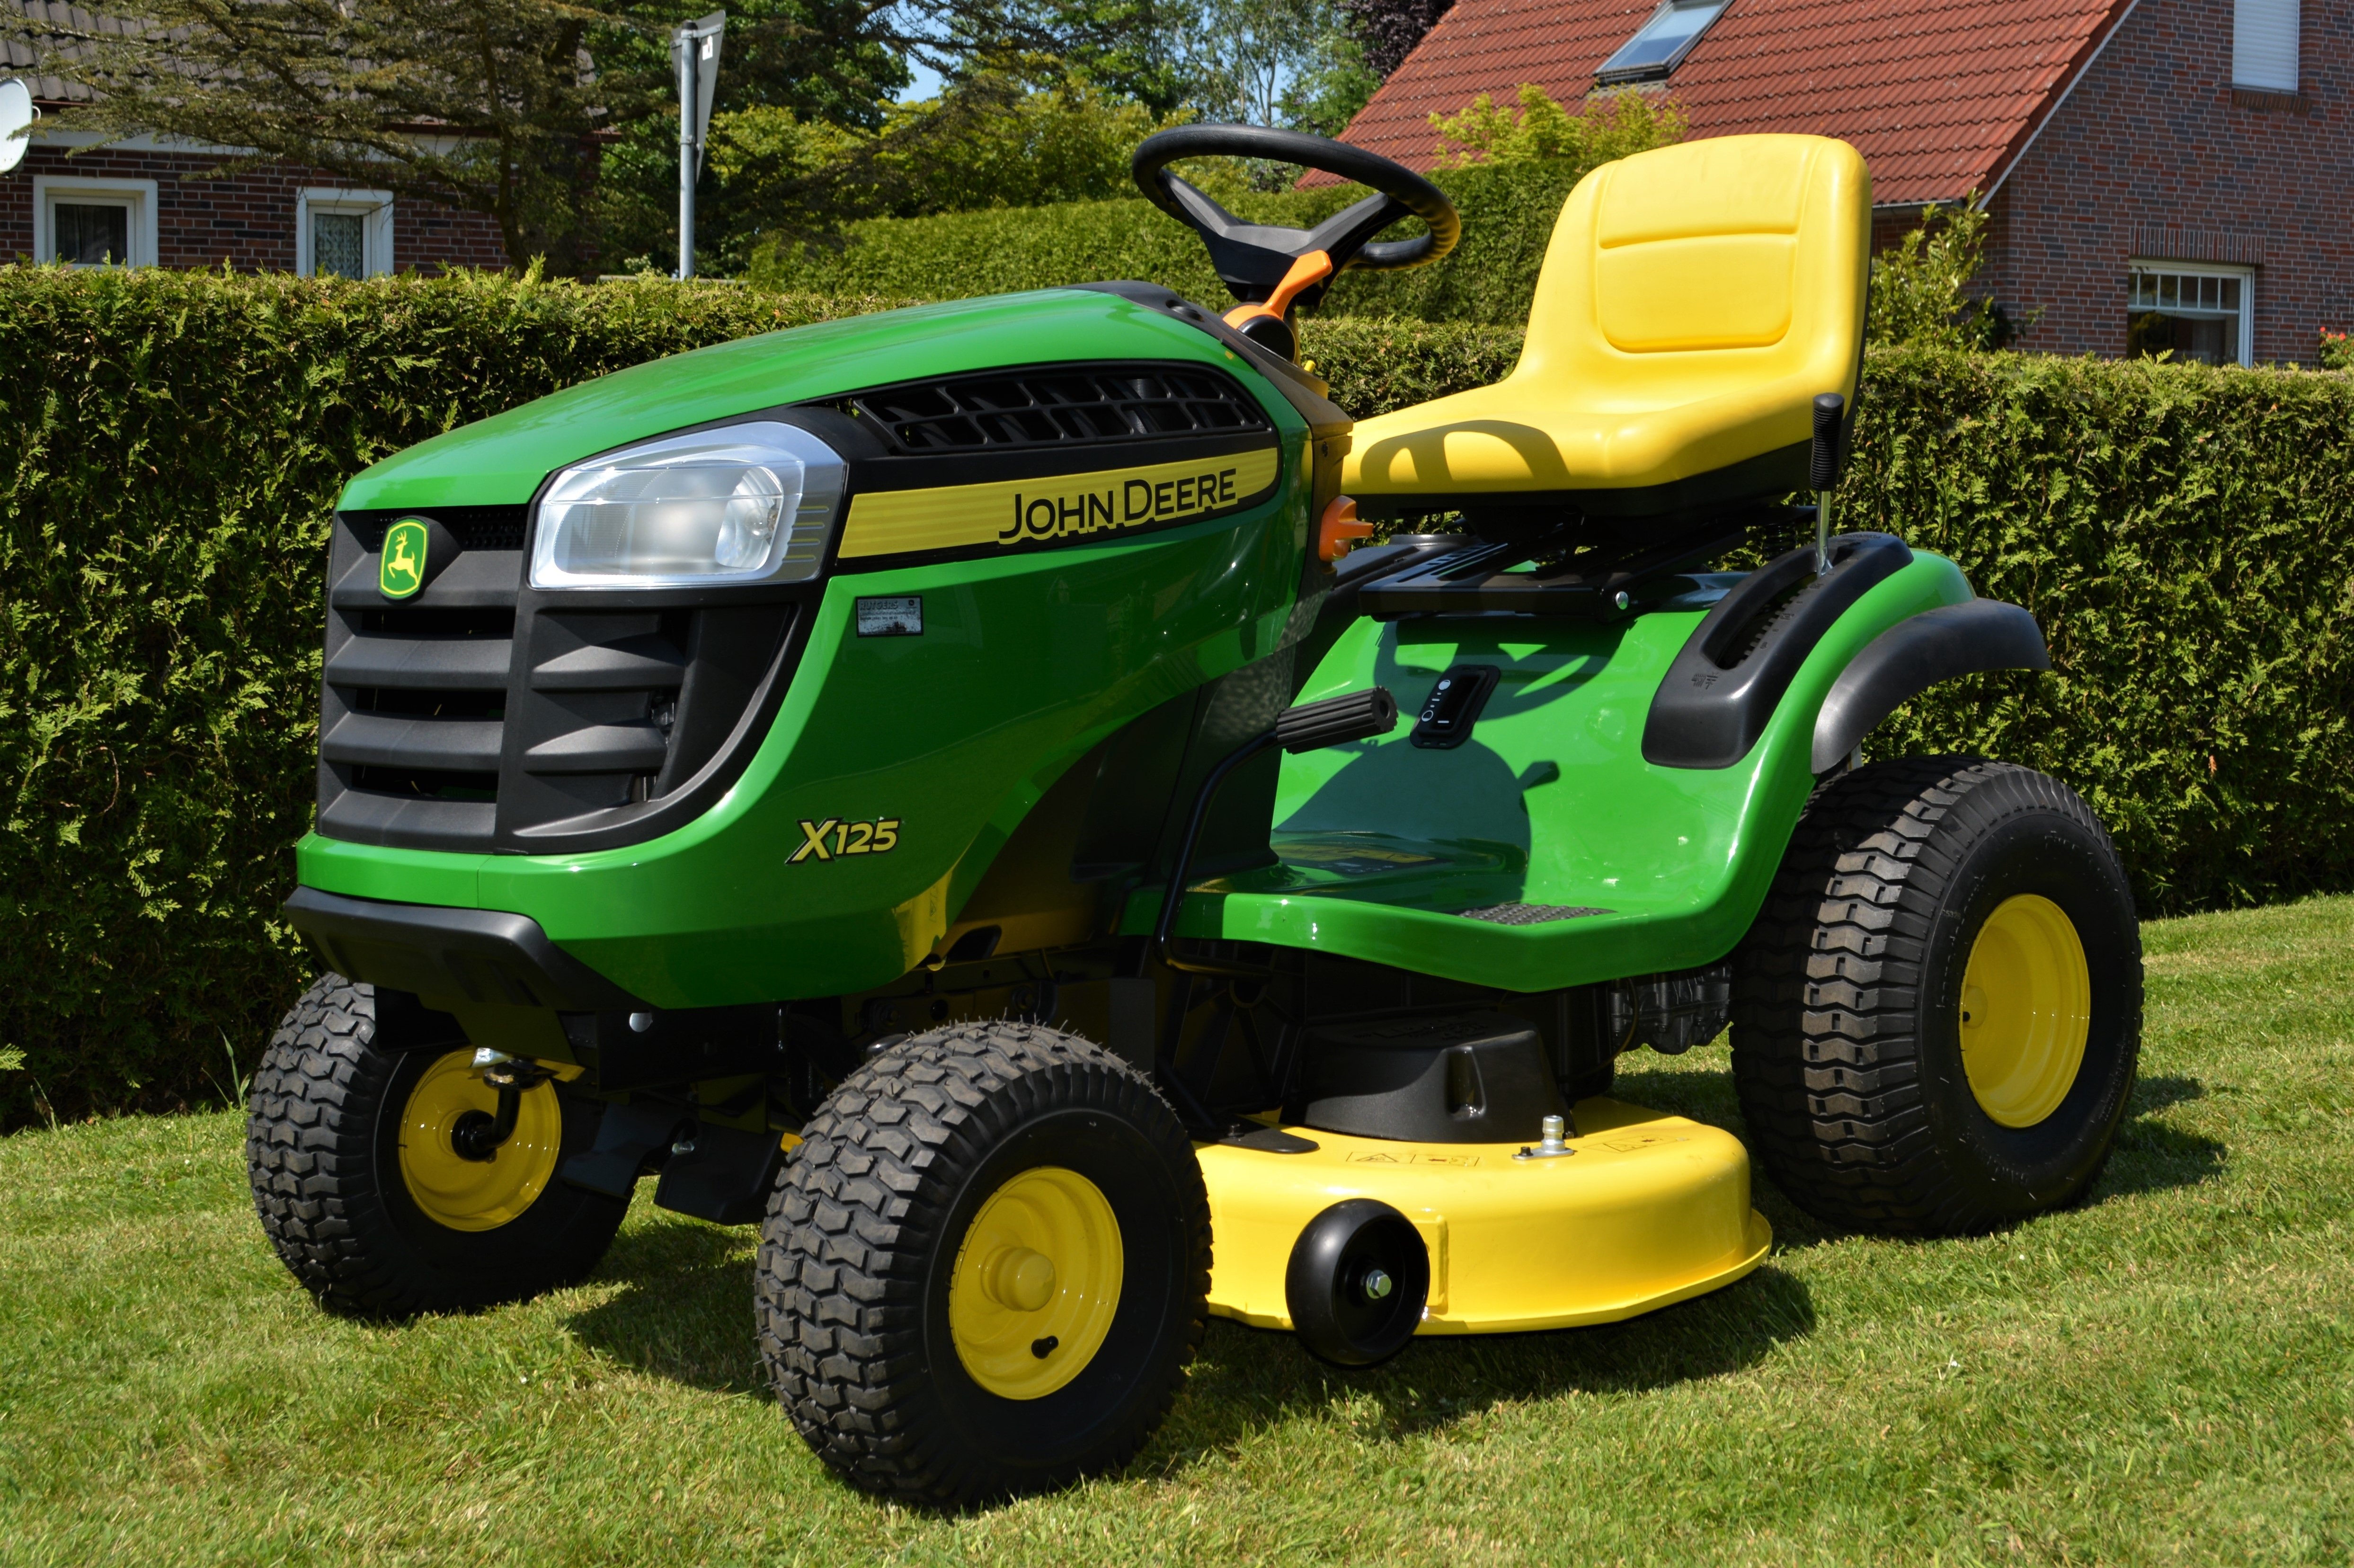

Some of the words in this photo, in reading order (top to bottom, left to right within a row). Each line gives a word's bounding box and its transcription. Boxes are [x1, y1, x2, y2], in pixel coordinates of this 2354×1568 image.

[998, 490, 1114, 540] JOHN
[1123, 468, 1237, 521] DEERE
[786, 817, 901, 864] X125
